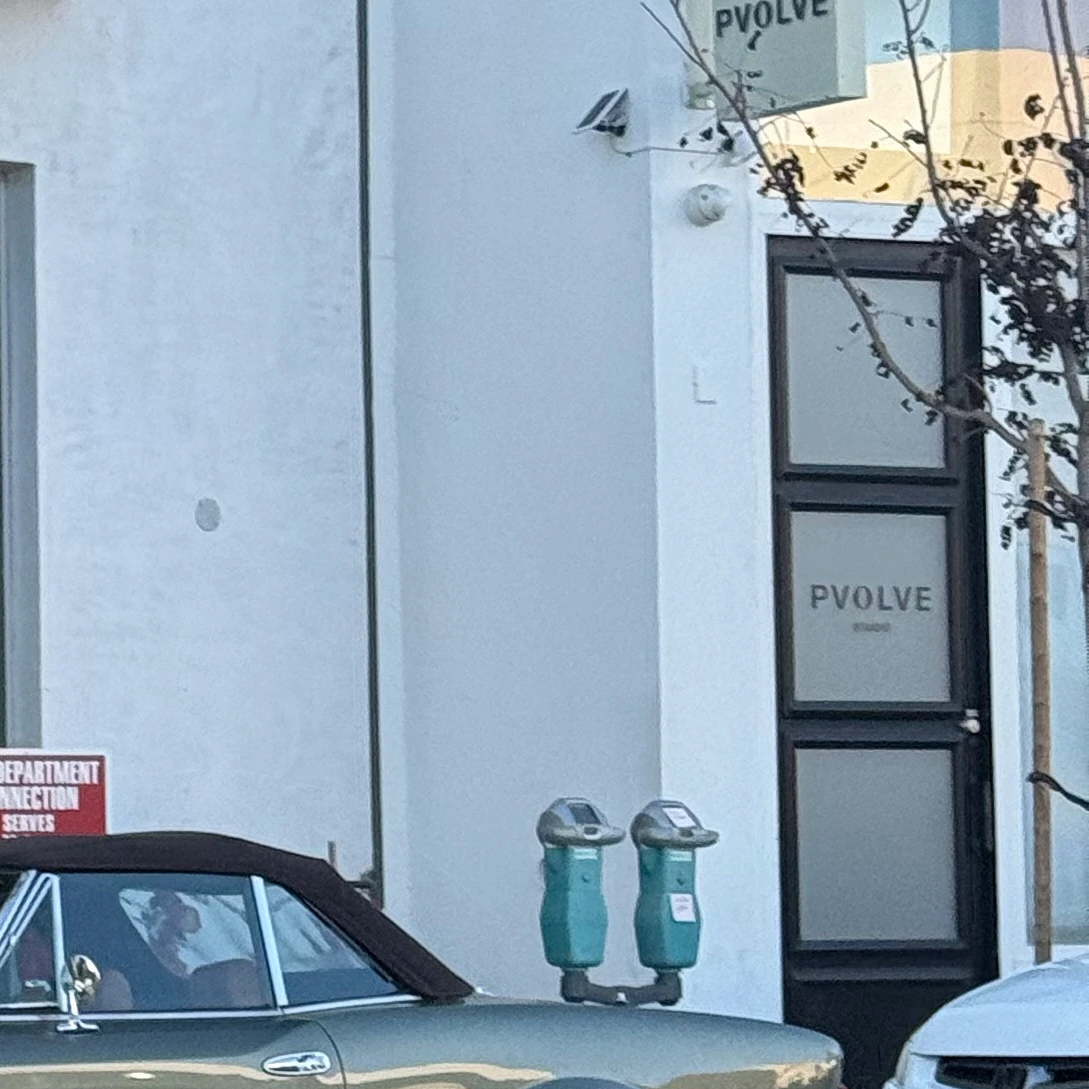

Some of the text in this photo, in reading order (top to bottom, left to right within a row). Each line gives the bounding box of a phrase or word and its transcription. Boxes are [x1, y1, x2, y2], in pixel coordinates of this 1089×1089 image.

[715, 0, 828, 38] PVOLVE
[810, 584, 931, 611] PVOLVE
[2, 814, 55, 832] SERVES
